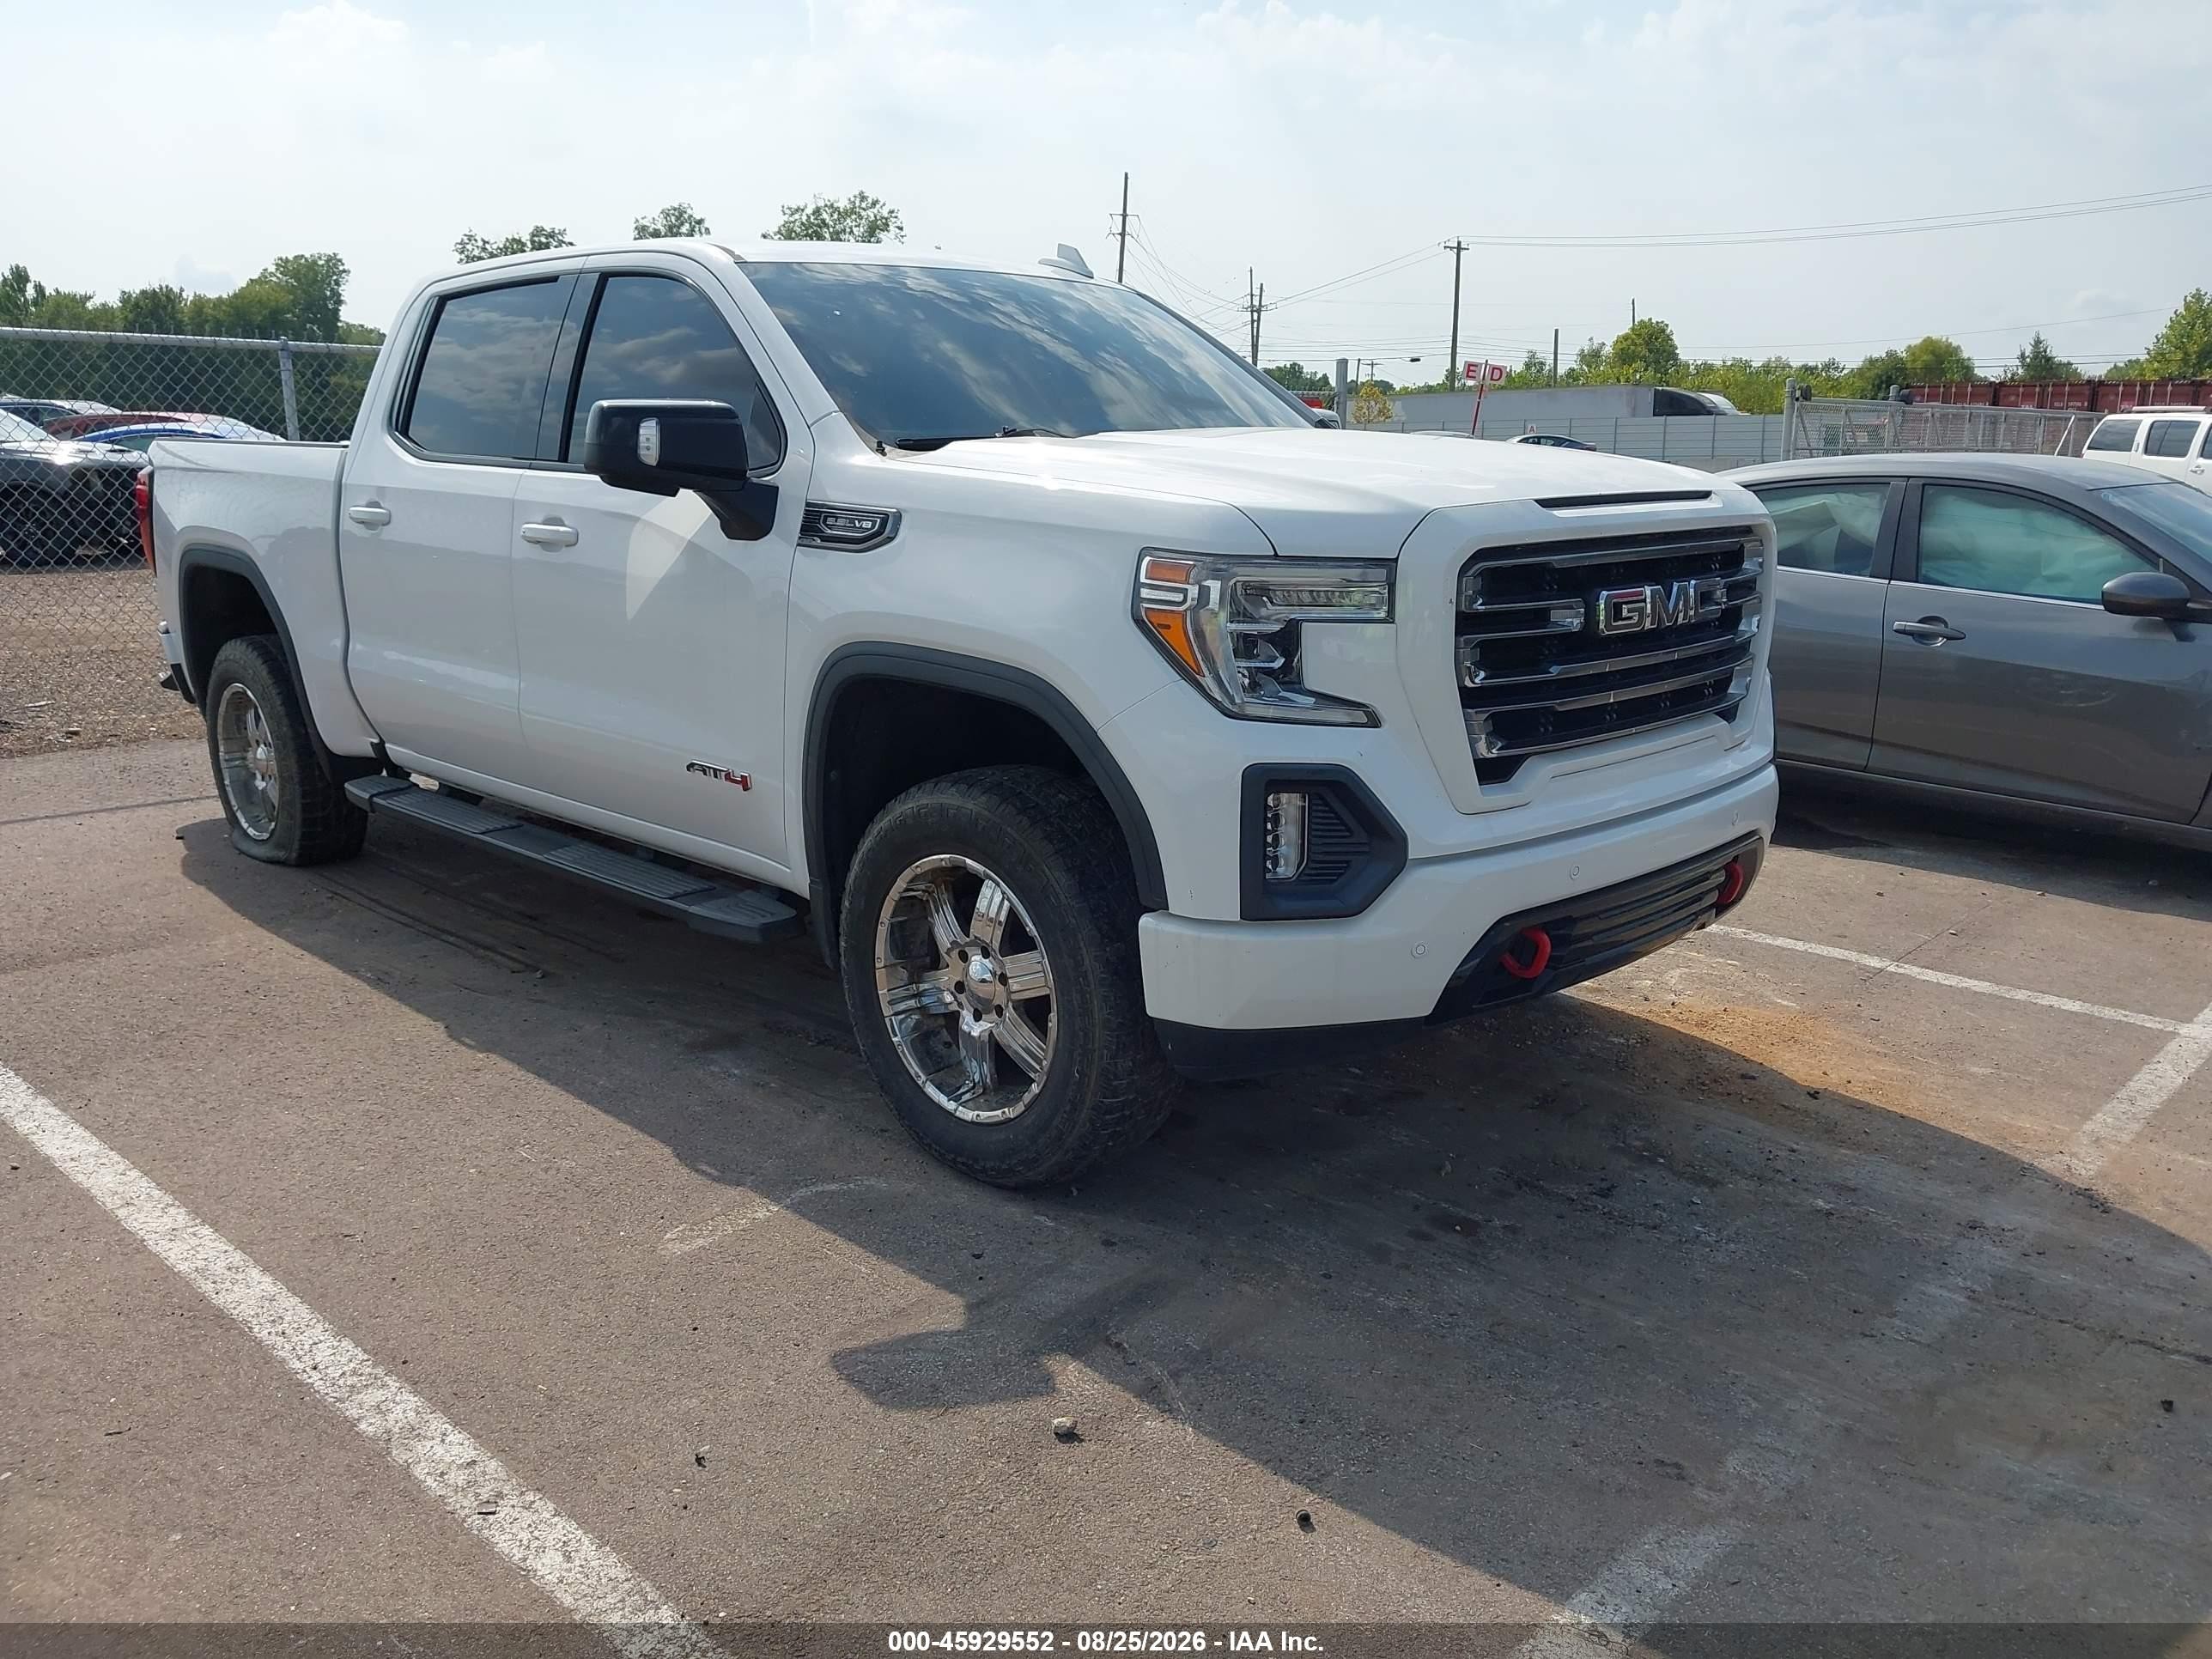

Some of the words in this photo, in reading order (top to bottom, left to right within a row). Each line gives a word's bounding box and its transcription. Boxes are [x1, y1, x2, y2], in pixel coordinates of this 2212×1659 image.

[1466, 363, 1479, 379] E
[1490, 367, 1504, 381] D
[1599, 578, 1728, 636] GMC
[686, 759, 752, 792] AT4
